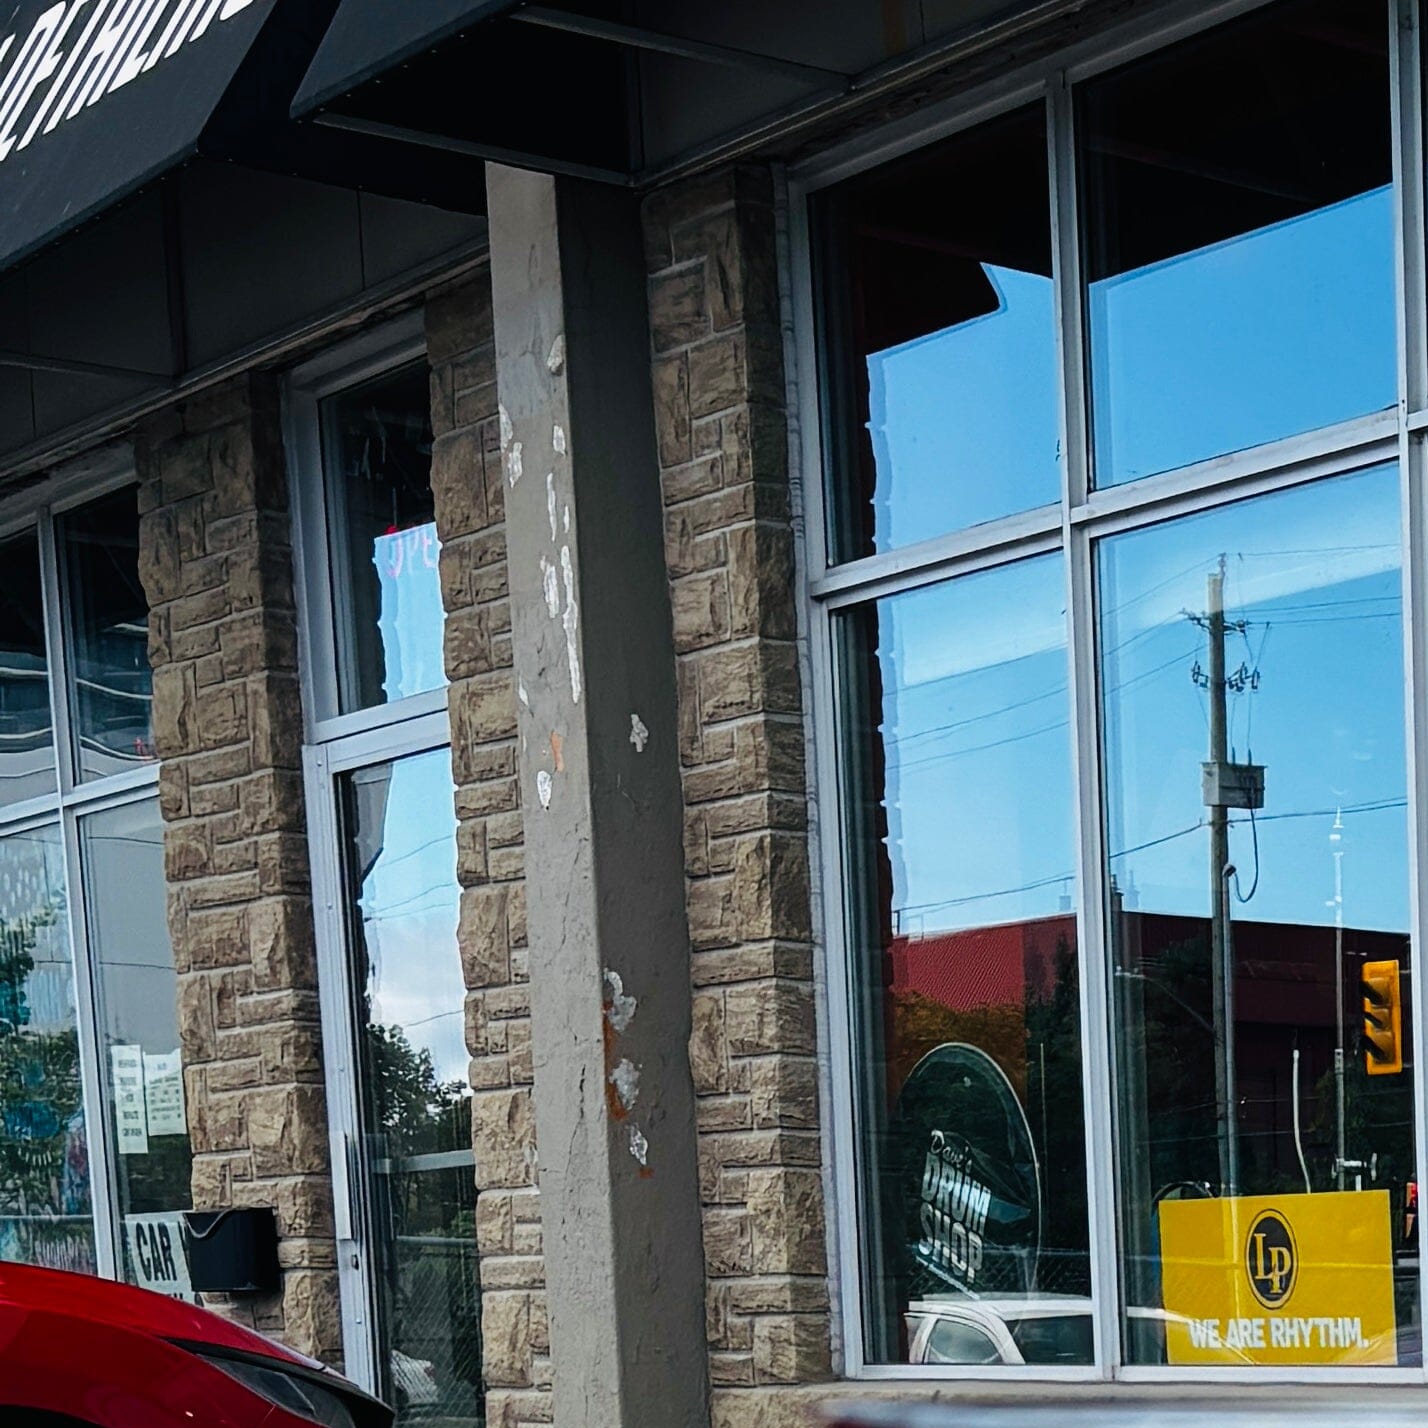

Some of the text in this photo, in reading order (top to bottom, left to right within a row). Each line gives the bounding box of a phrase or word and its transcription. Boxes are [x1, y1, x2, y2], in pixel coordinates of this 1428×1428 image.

[921, 1152, 991, 1237] DRUM
[136, 1221, 177, 1282] CAR
[918, 1202, 983, 1284] SHOP
[1188, 1317, 1370, 1349] WE ARE RHYTHM.
